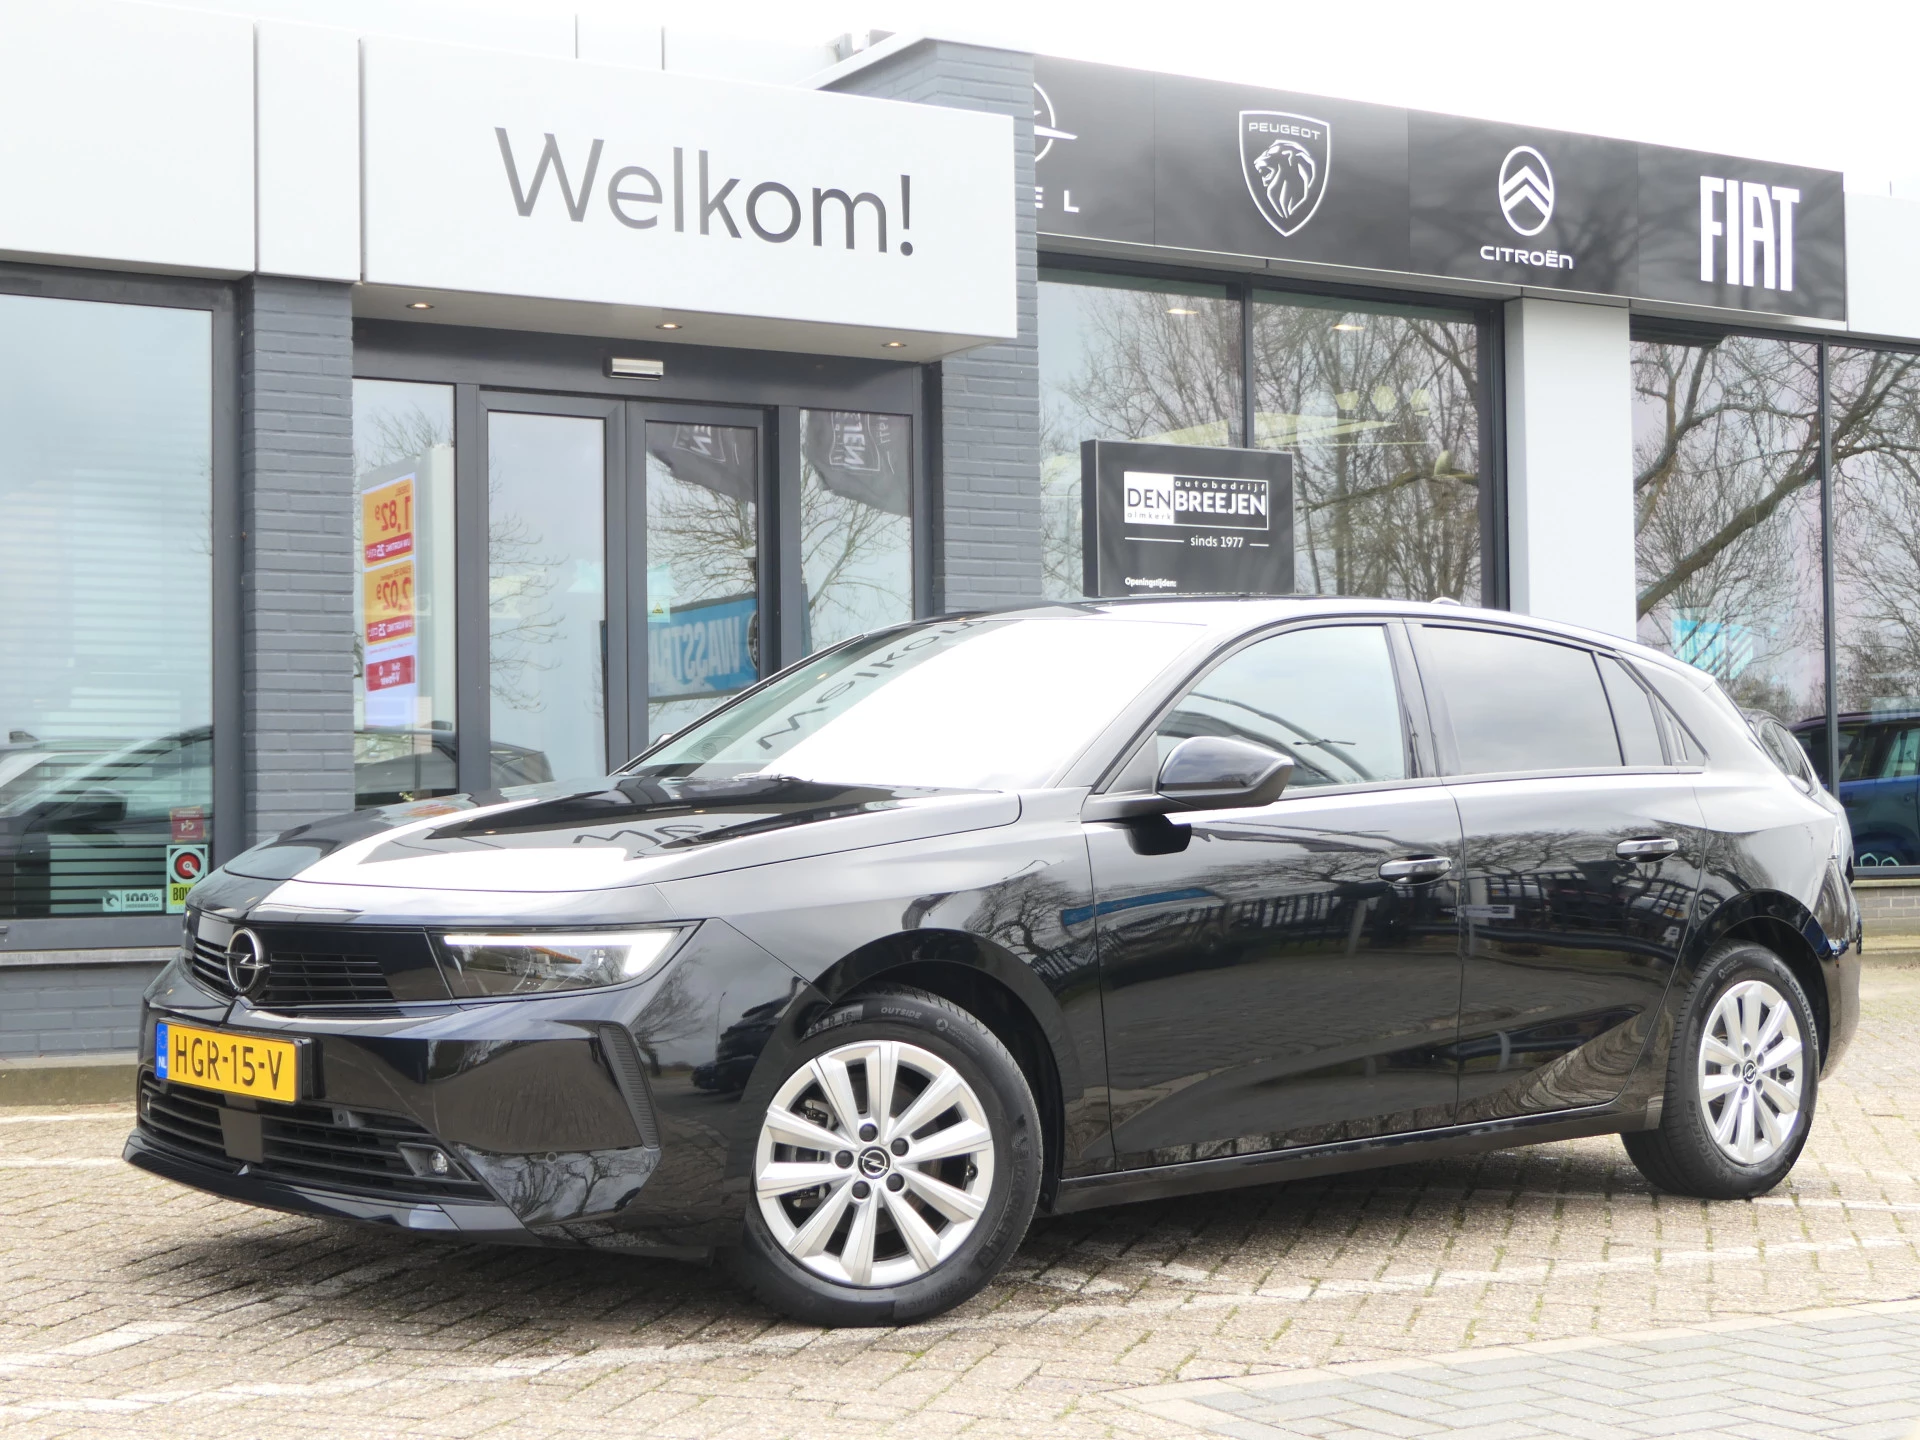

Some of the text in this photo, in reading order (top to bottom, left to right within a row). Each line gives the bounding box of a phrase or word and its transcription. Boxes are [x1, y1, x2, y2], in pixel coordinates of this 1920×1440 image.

[1248, 121, 1321, 141] PEUGEOT
[493, 126, 914, 257] Welkom!
[1700, 175, 1800, 292] FIAT
[1174, 480, 1266, 493] autobedrijf
[1127, 488, 1266, 516] DEN BREEJEN
[1127, 511, 1172, 520] almkerk
[1190, 535, 1244, 548] sinds 1977
[1125, 576, 1177, 589] Openingstijden:
[125, 892, 159, 903] 100%
[880, 1006, 922, 1020] OUTSIDE
[158, 1055, 167, 1069] NL
[175, 1034, 283, 1091] HGR-15-V
